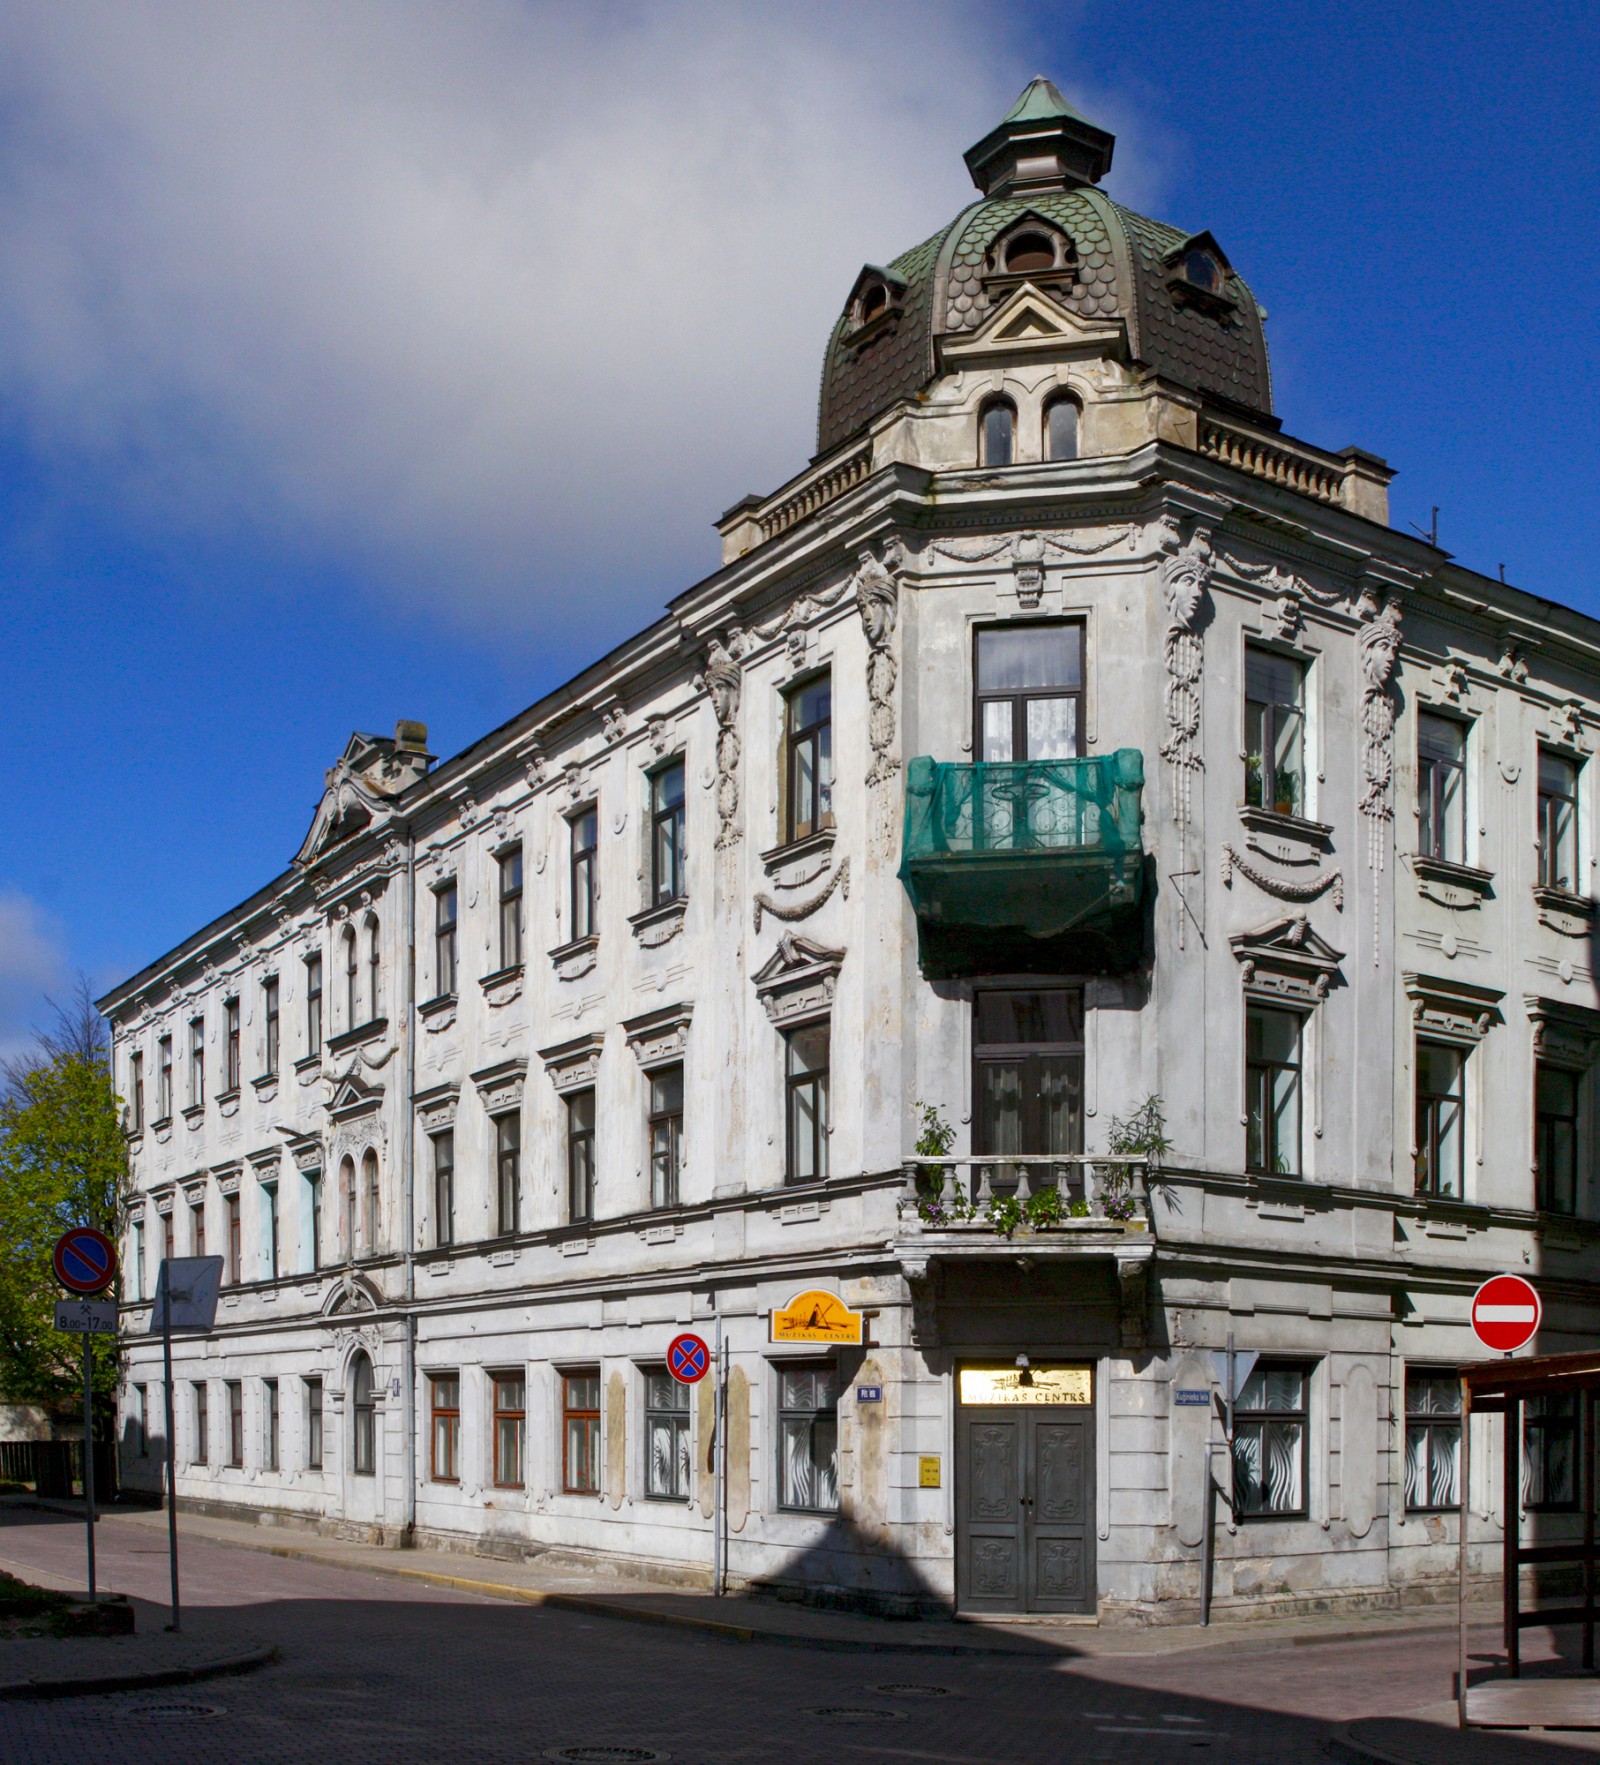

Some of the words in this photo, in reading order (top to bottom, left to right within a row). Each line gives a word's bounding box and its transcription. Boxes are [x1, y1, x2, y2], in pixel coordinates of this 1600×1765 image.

[60, 1316, 113, 1330] 8.00-17.00
[824, 1332, 856, 1340] CENTRS
[1035, 1391, 1086, 1403] CENTRS
